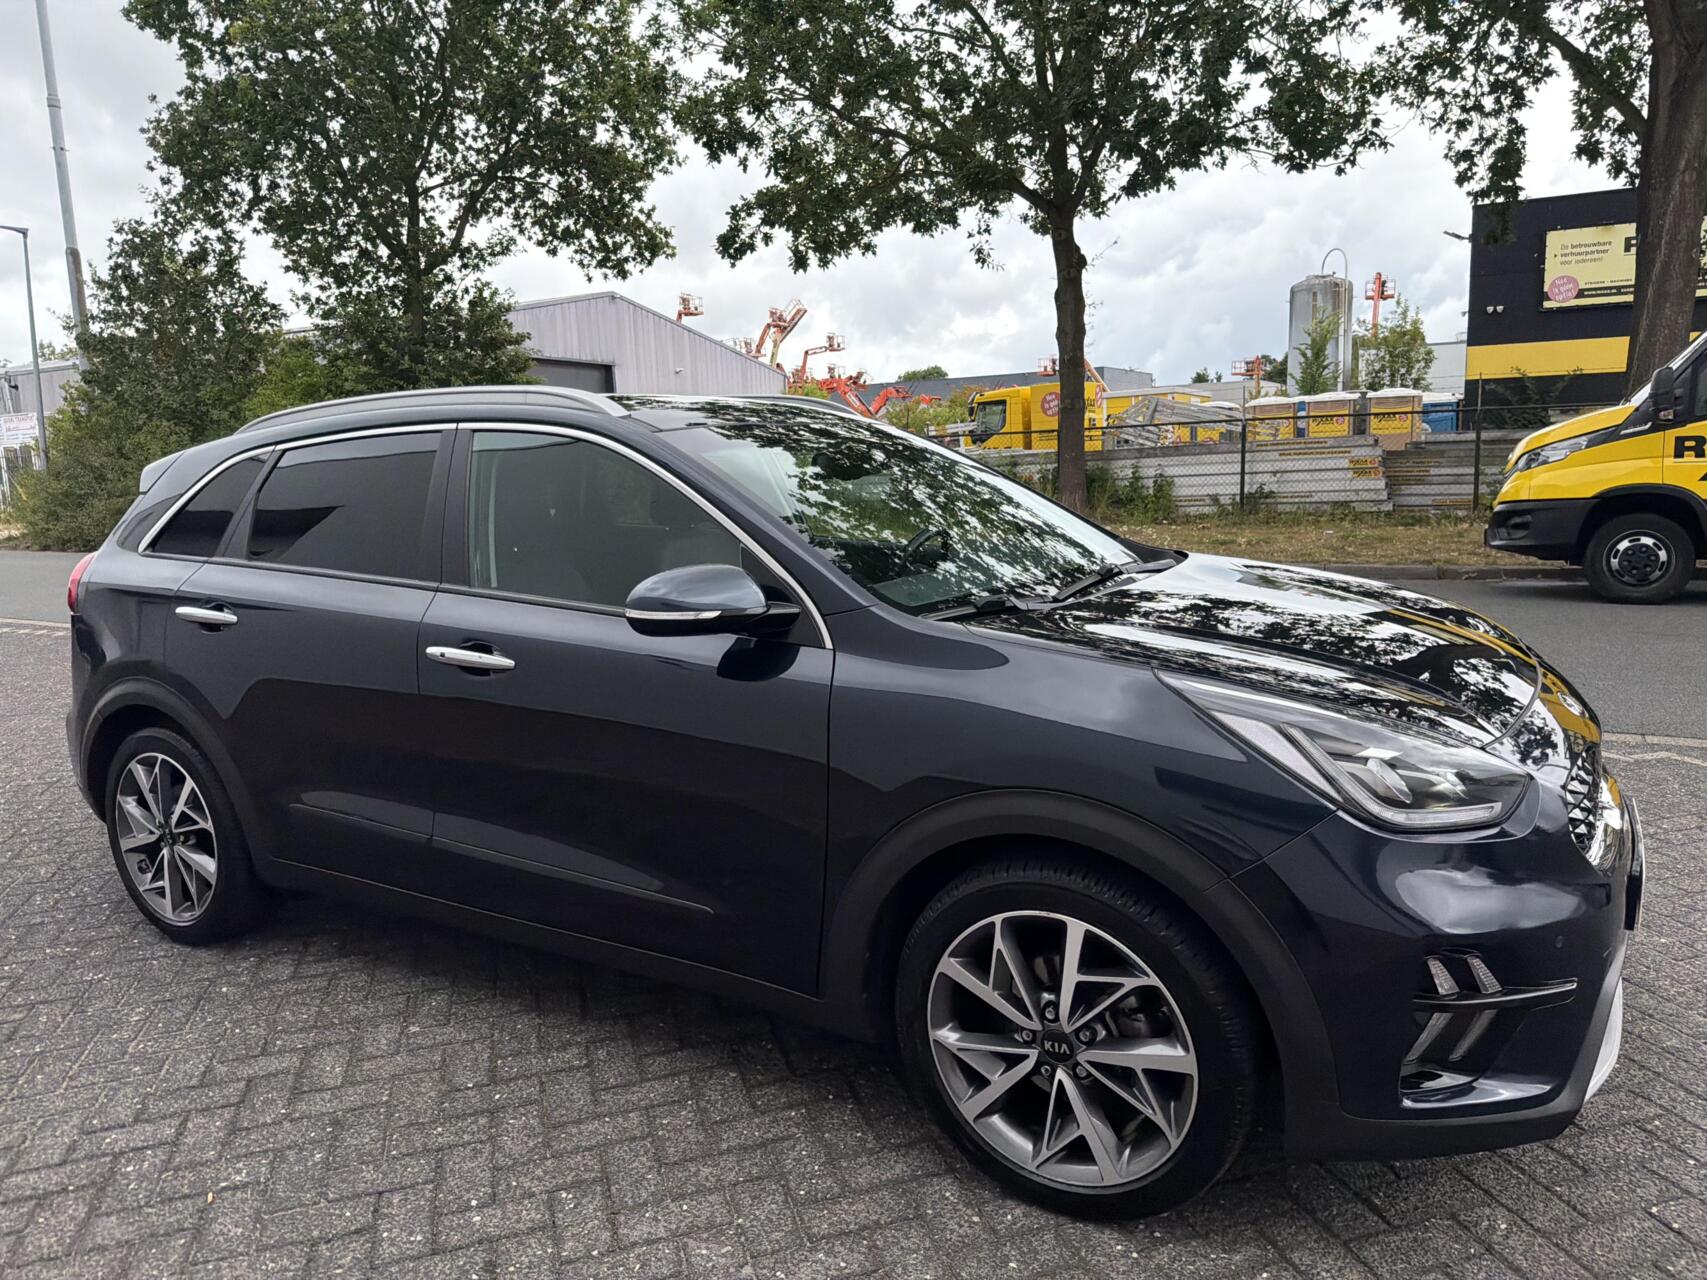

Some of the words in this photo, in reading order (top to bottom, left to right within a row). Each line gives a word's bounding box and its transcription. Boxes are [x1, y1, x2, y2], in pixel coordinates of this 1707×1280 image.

[1570, 240, 1612, 249] betrouwbare
[1560, 248, 1609, 258] verhuurpartner
[1044, 1040, 1071, 1055] KIA
